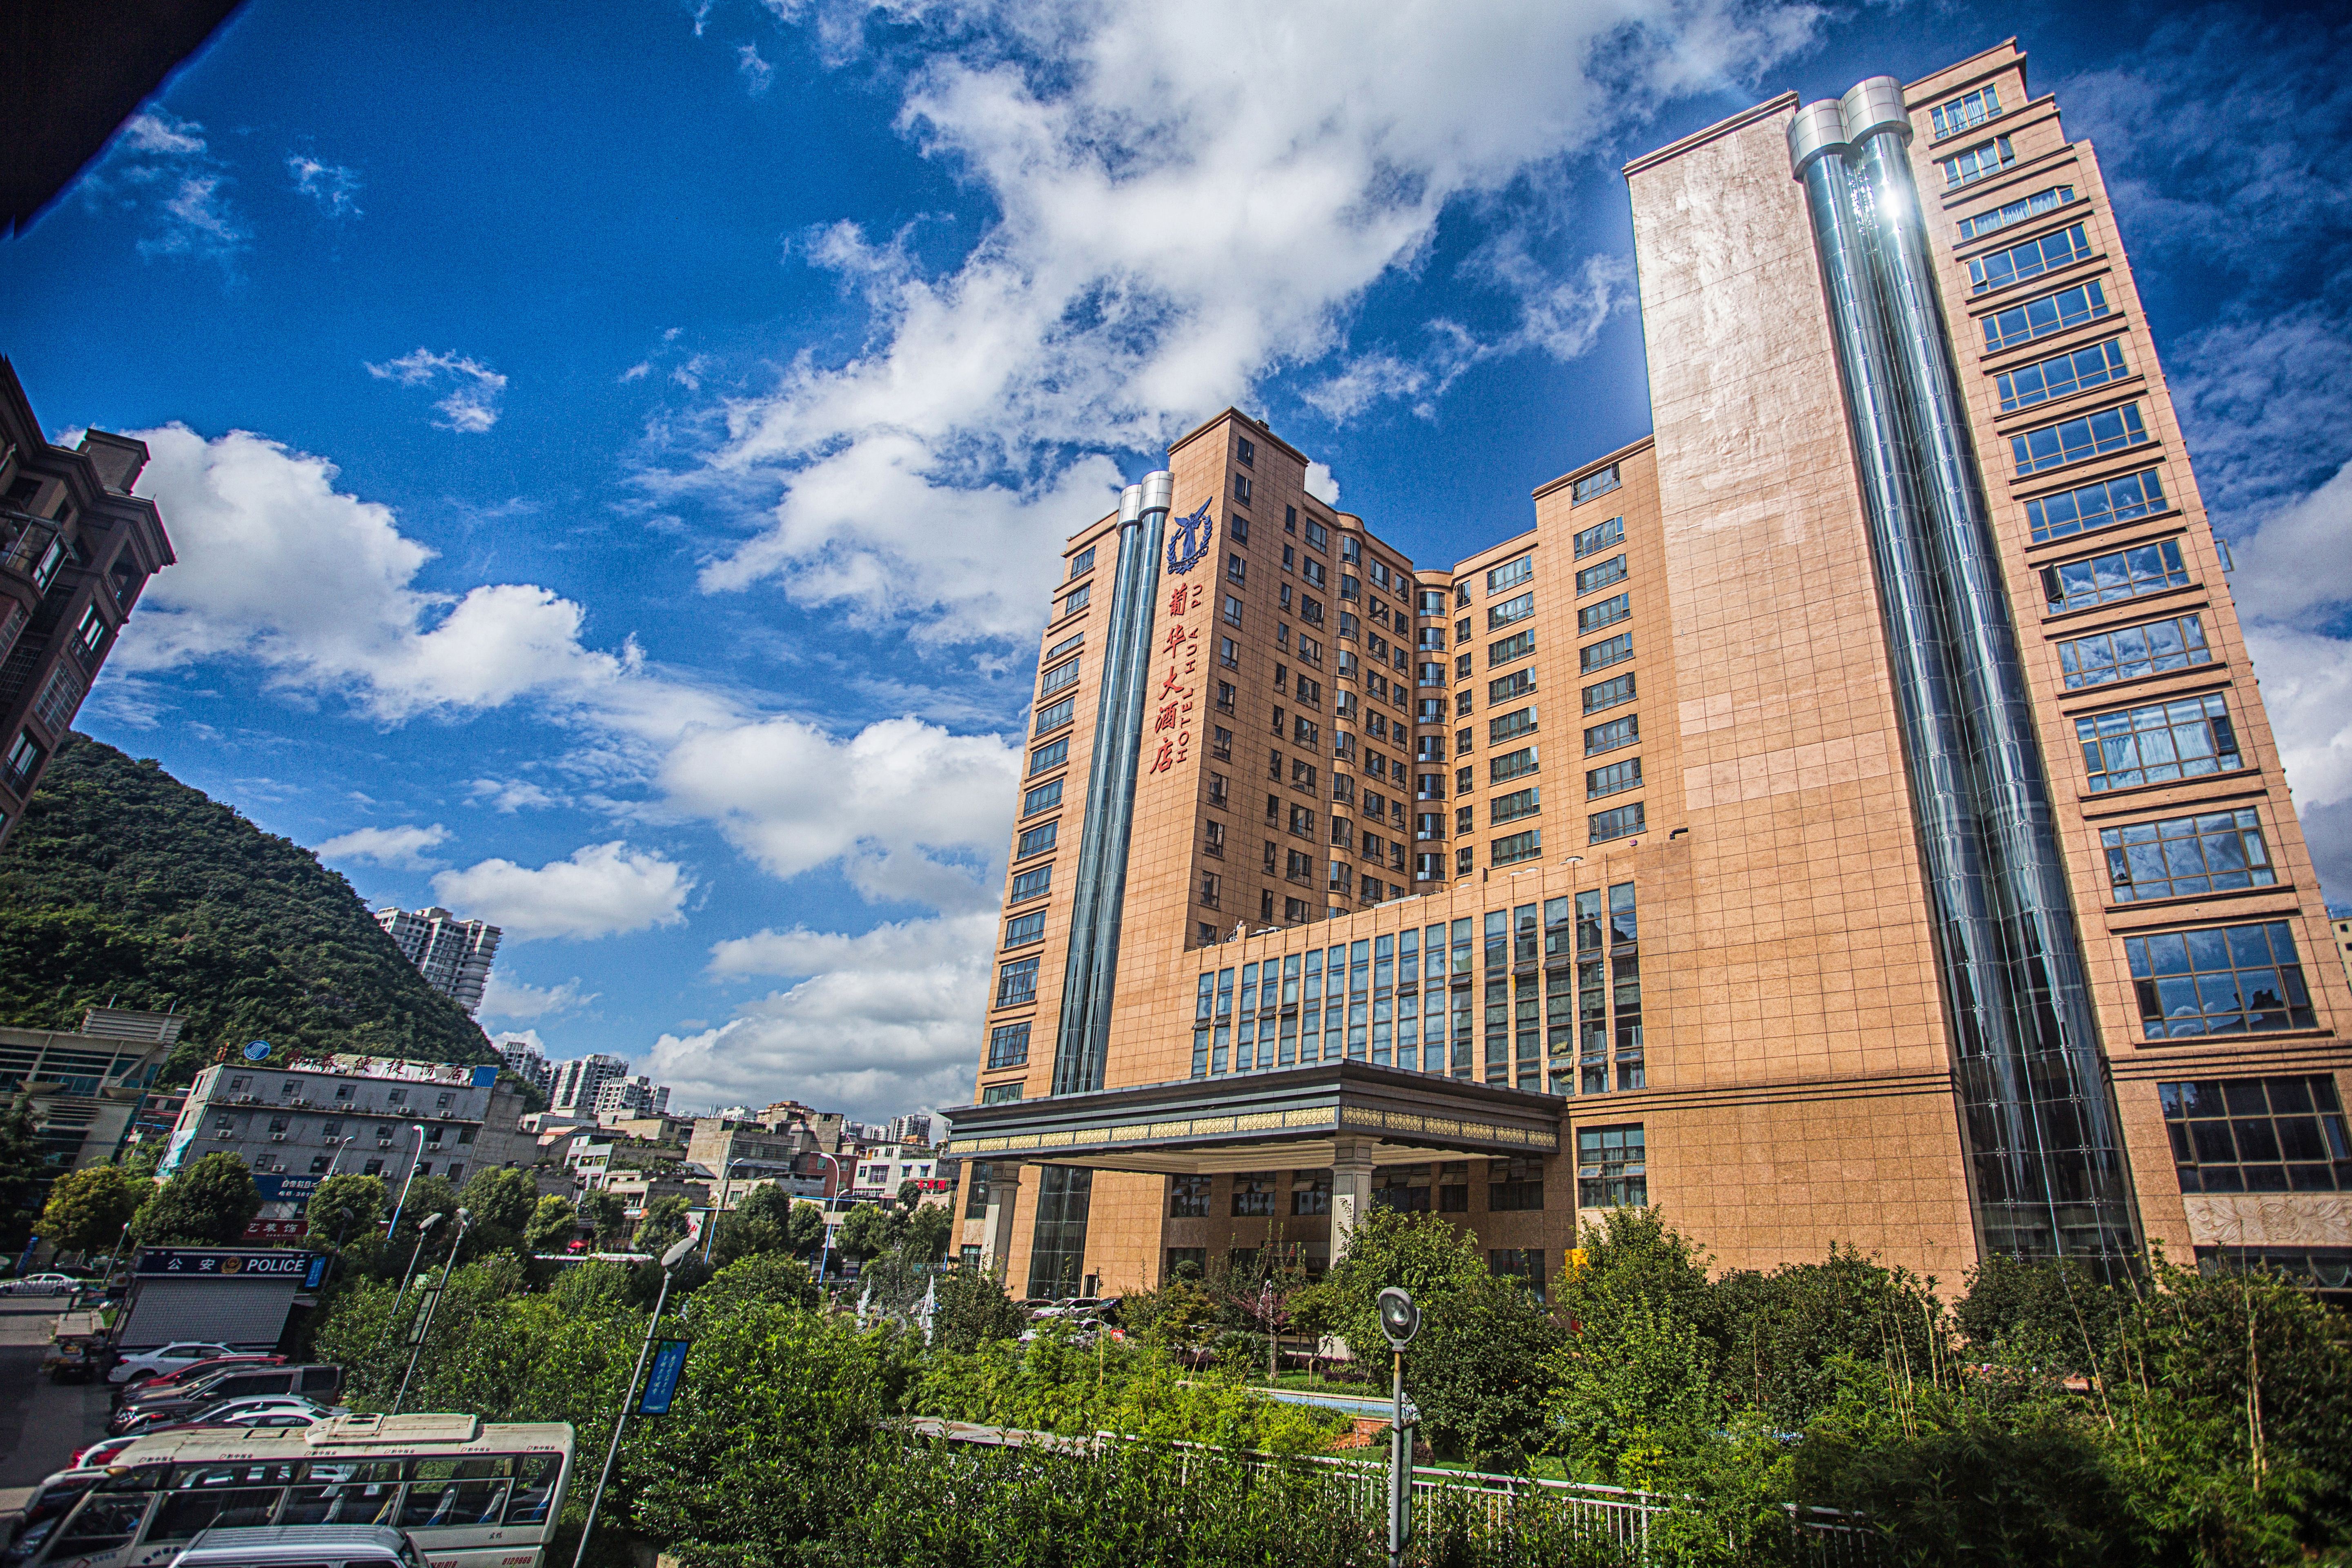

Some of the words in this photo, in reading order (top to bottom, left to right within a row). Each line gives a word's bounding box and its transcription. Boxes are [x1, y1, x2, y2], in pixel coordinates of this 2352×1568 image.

[1191, 584, 1203, 608] PU
[1185, 627, 1198, 675] HUA
[1177, 688, 1193, 763] HOTEL
[167, 1258, 216, 1271] 公安
[246, 1259, 306, 1272] POLICE
